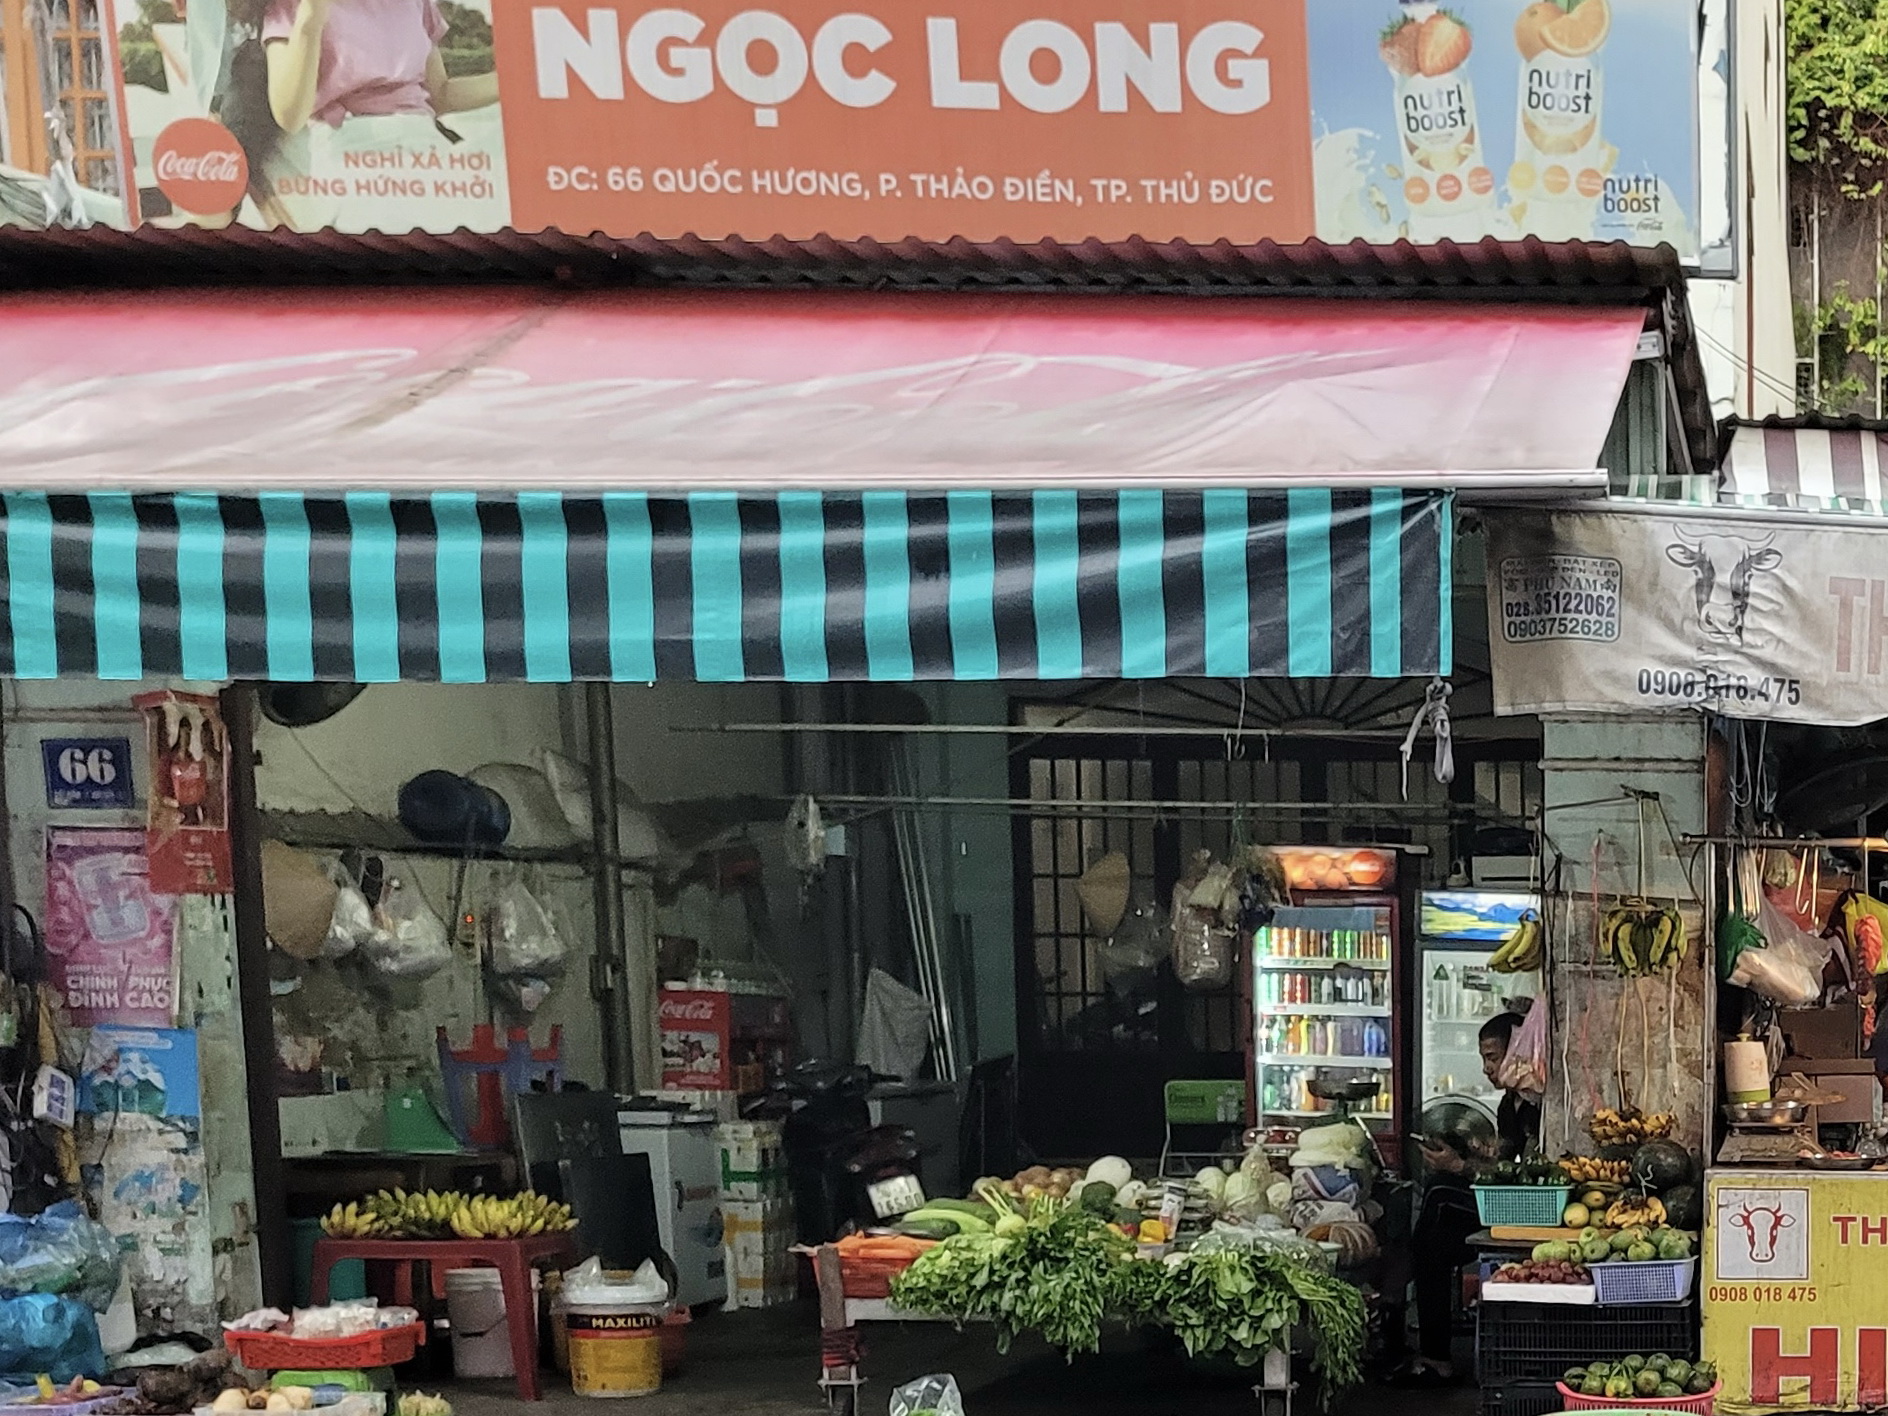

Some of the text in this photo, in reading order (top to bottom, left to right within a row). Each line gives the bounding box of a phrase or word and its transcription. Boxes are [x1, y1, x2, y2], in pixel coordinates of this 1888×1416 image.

[531, 7, 1271, 127] NGỌC LONG
[1529, 68, 1592, 91] nutri
[1404, 85, 1463, 112] nutri
[1527, 86, 1593, 114] boost
[1405, 106, 1467, 133] boost
[547, 165, 598, 191] ĐC:
[606, 167, 644, 191] 66
[652, 159, 743, 194] QUỐC
[751, 167, 871, 200] HƯƠNG,
[879, 173, 903, 198] P.
[910, 166, 995, 201] THẢO
[1090, 178, 1133, 203] TP.
[1140, 170, 1199, 204] THỦ
[1208, 173, 1275, 204] ĐỨC
[1602, 193, 1661, 214] boost
[1507, 617, 1615, 638] 0903752628
[59, 748, 117, 785] 66
[1709, 1286, 1817, 1302] 0908 018 475
